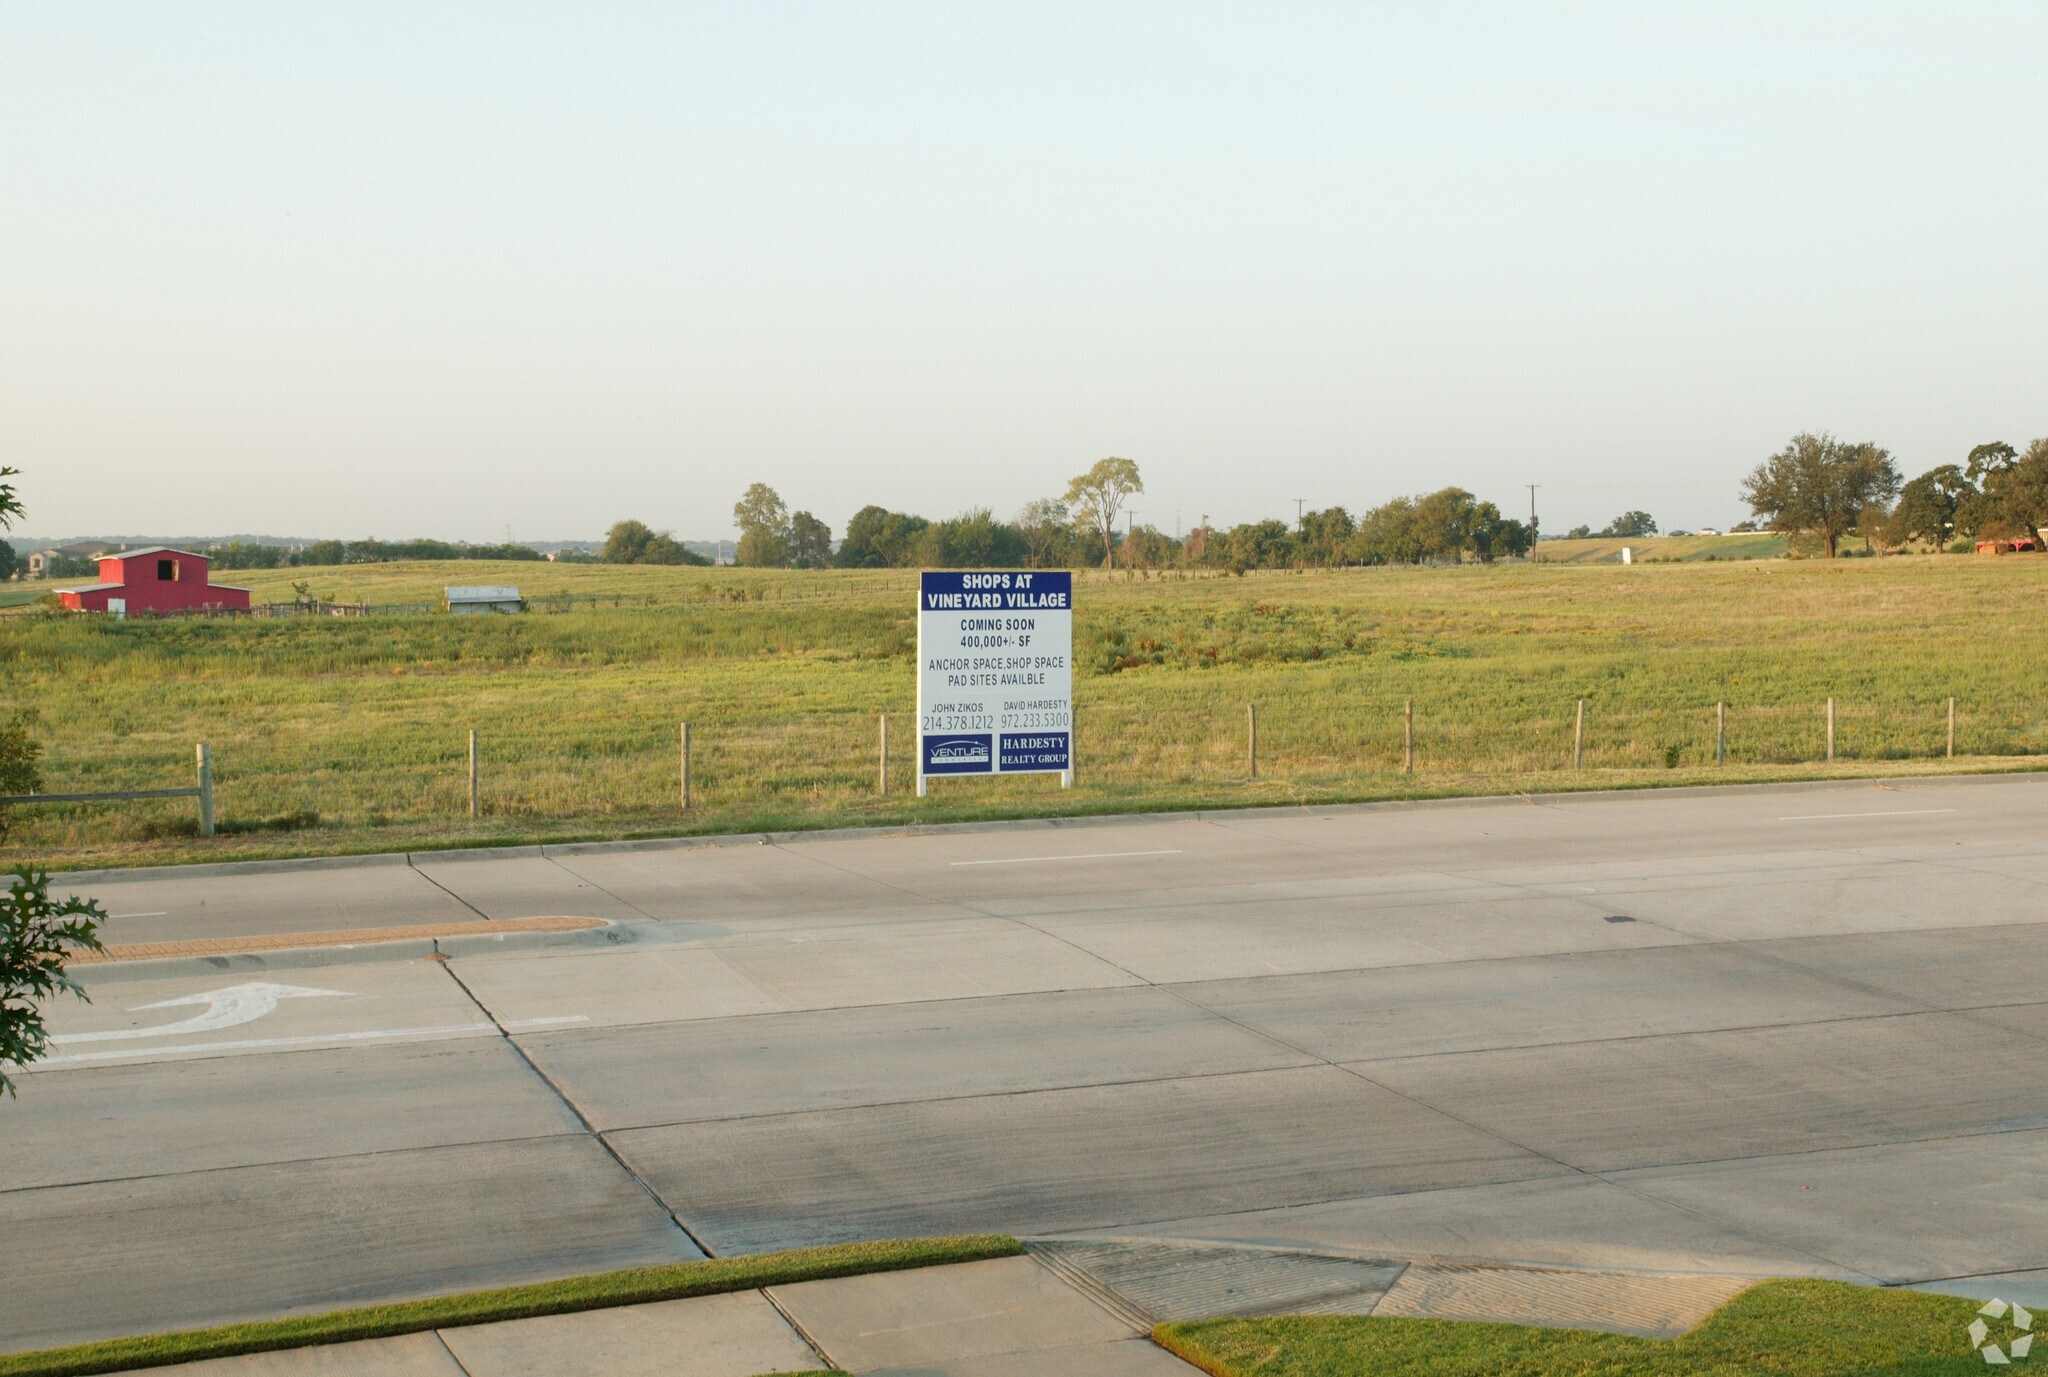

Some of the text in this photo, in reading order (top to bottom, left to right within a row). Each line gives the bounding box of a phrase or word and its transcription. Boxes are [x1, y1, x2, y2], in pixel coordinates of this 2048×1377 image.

[963, 575, 1032, 588] SHOPS AT
[928, 593, 1066, 608] VINEYARD VILLAGE
[961, 619, 1034, 630] COMING SOON
[961, 636, 1030, 650] 400,000+/- SF
[929, 658, 969, 670] ANCHOR
[1035, 657, 1064, 668] SPACE
[949, 673, 1045, 686] PAD SITES AVAILBLE
[932, 703, 983, 713] JOHN ZIKOS
[1004, 700, 1068, 710] DAVID HARDESTY
[924, 716, 993, 730] 214.378.1212
[1002, 713, 1068, 728] 972.233.5300
[1004, 738, 1065, 749] HARDESTY
[931, 747, 988, 757] VENTURE
[1002, 754, 1067, 764] REALTY GROUP
